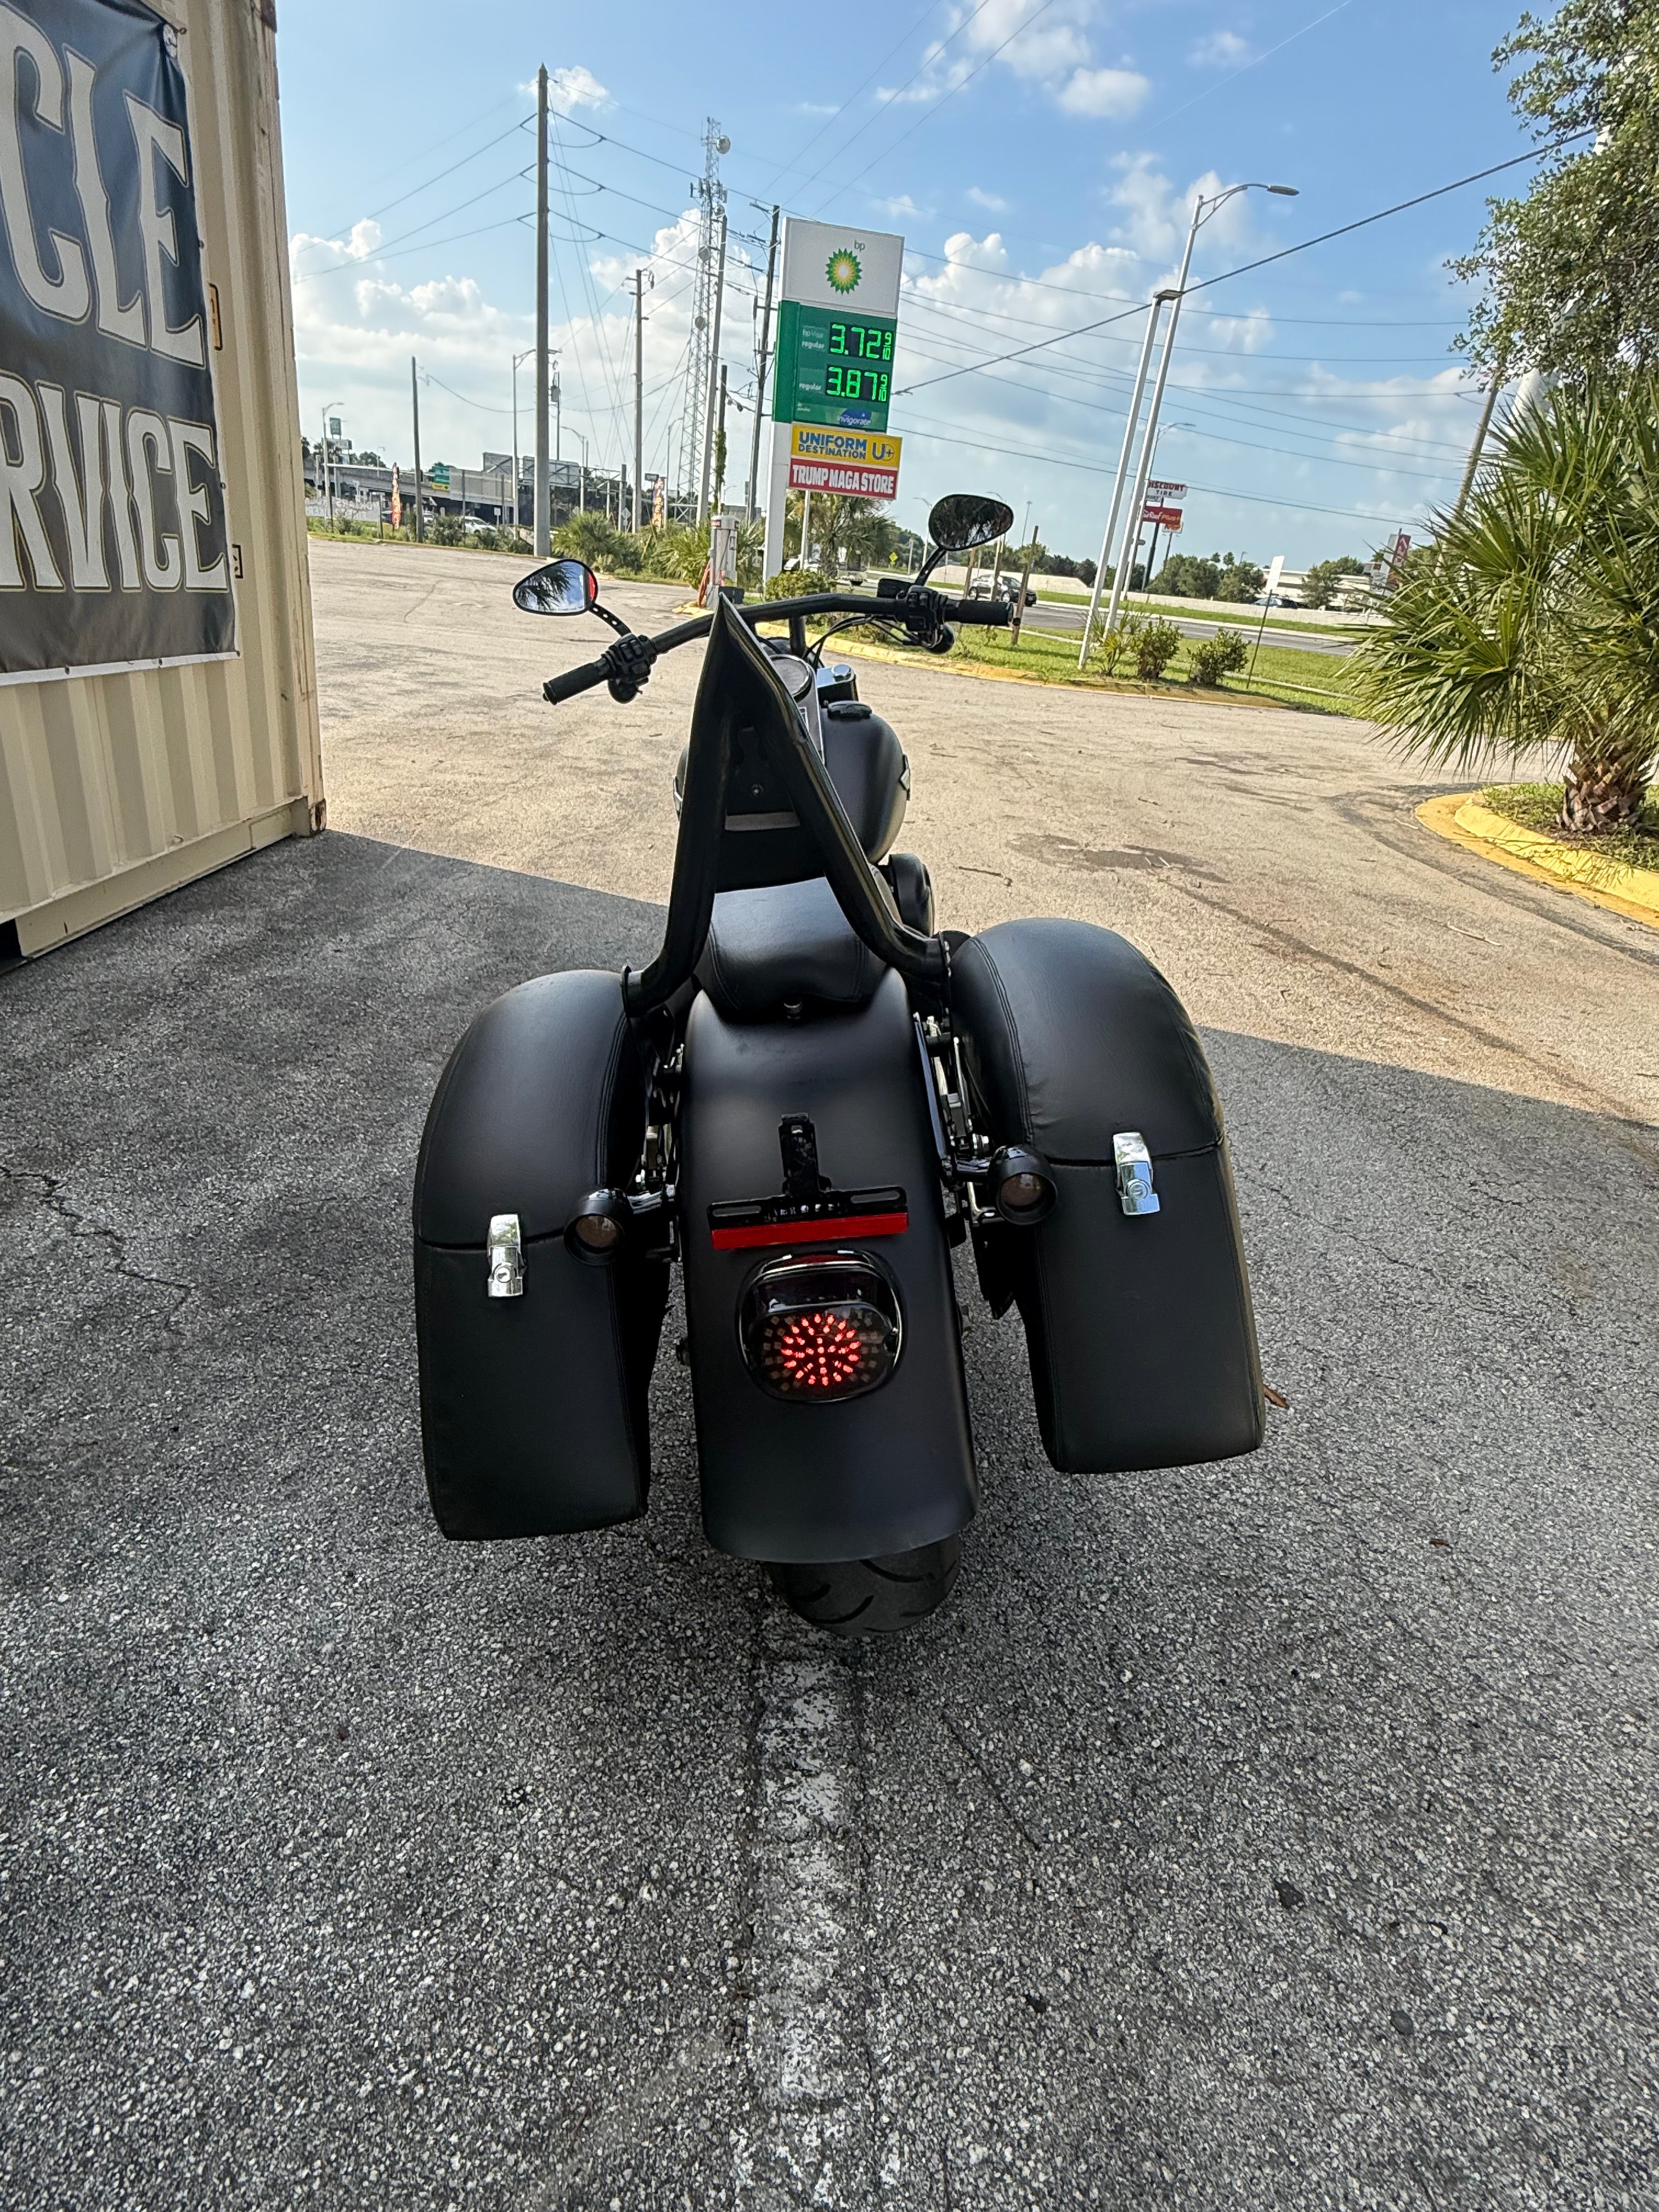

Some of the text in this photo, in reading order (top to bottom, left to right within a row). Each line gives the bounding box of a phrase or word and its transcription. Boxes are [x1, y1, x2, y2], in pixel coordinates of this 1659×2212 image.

[854, 239, 866, 253] bp
[802, 341, 825, 349] regular
[830, 324, 882, 359] 3.72
[799, 382, 822, 391] regular
[826, 366, 878, 400] 3.87
[799, 431, 868, 452] UNIFORM
[798, 443, 866, 460] DESTINATION
[793, 464, 894, 494] TRUMP MAGA STORE
